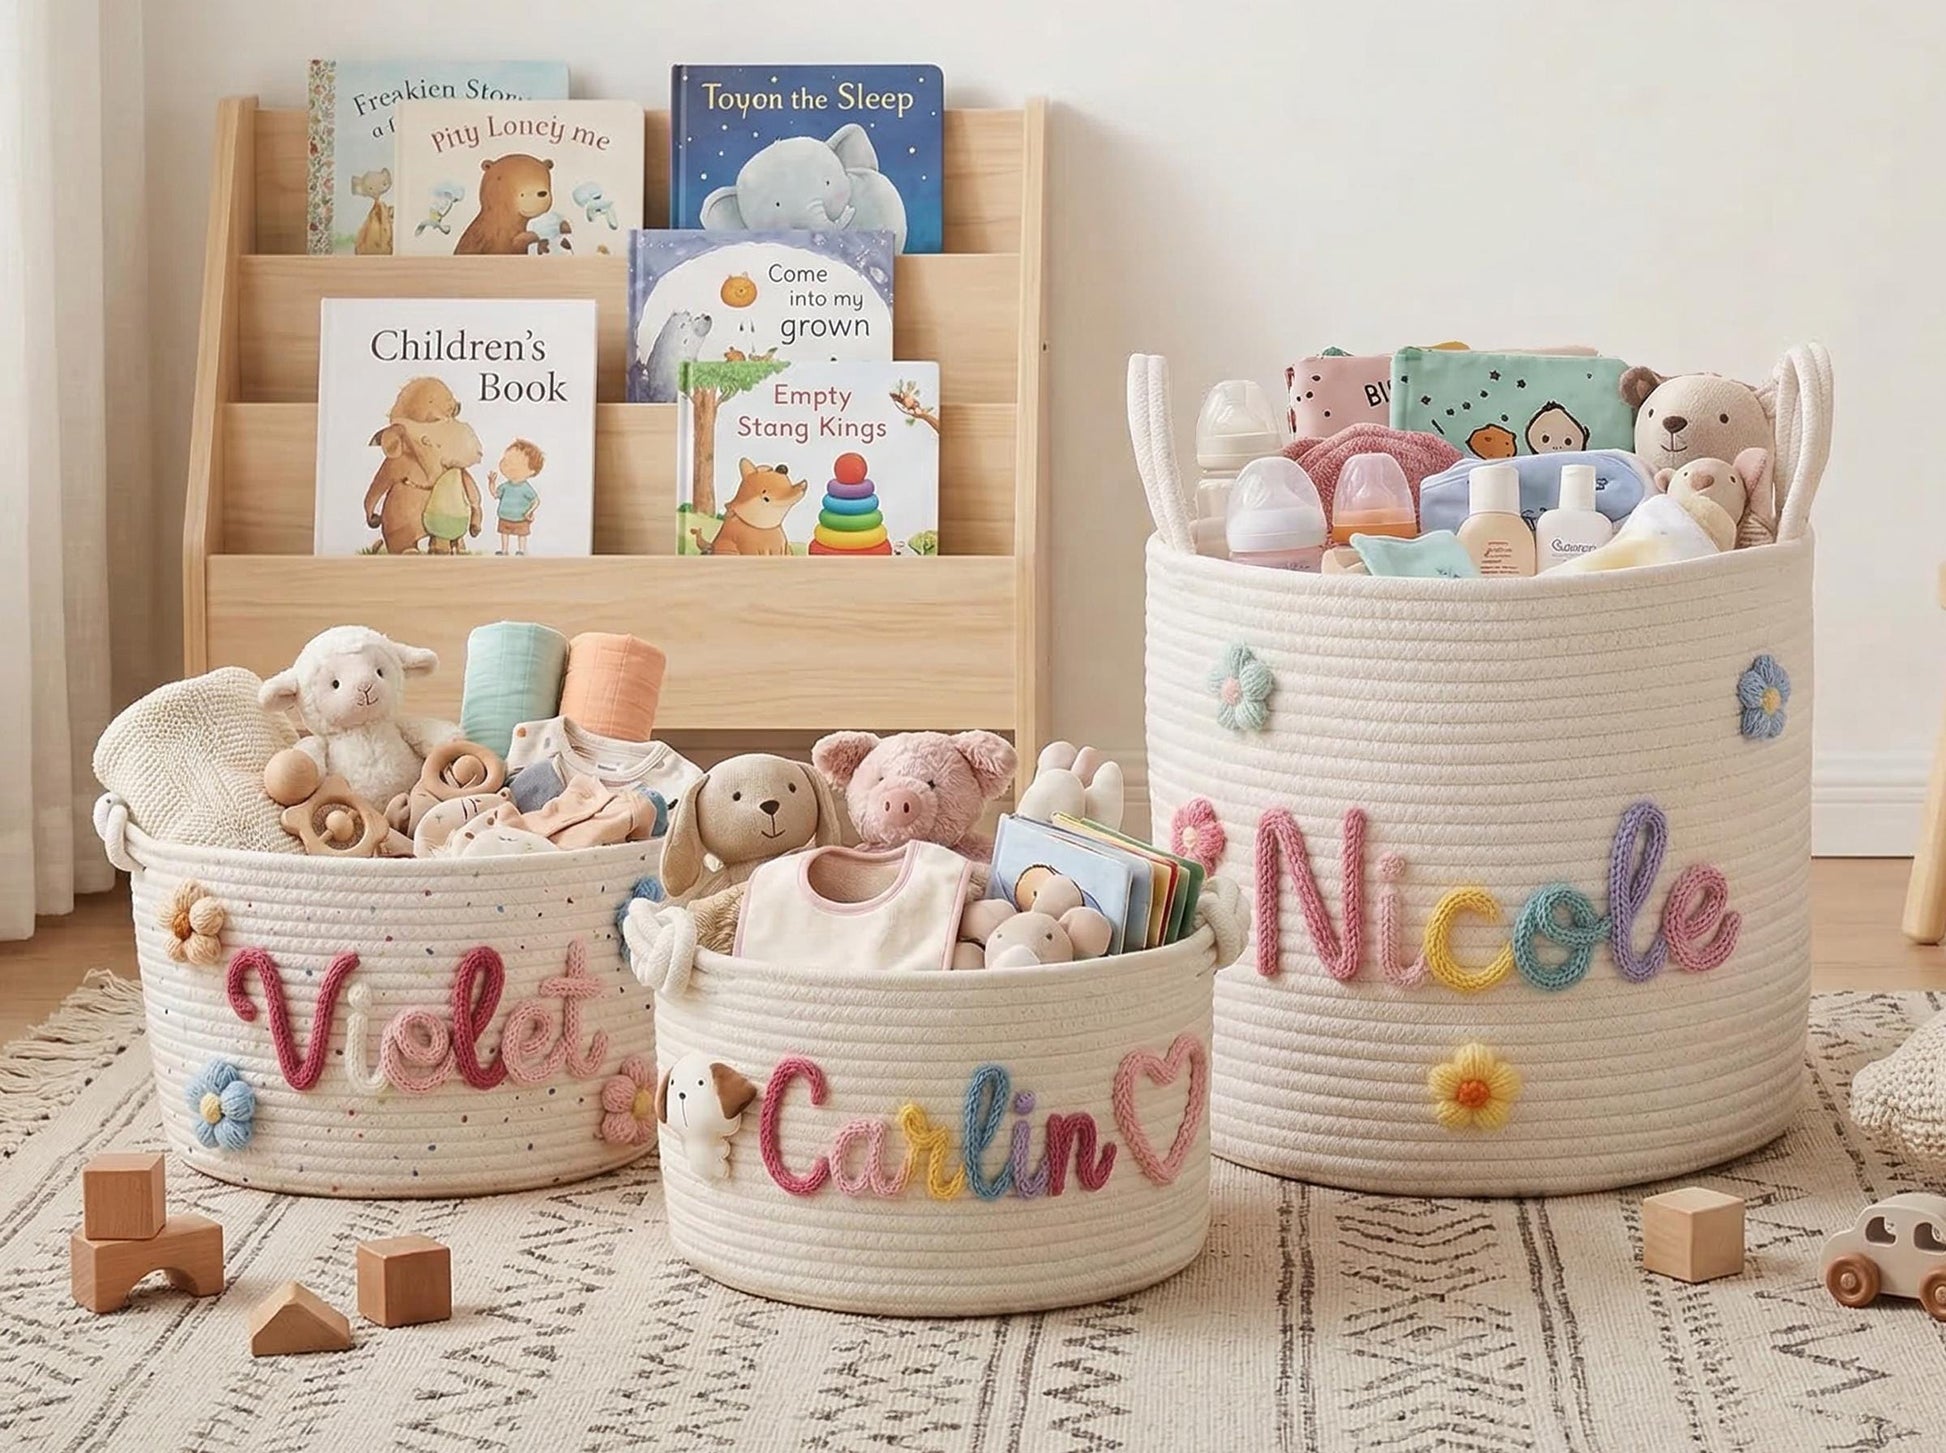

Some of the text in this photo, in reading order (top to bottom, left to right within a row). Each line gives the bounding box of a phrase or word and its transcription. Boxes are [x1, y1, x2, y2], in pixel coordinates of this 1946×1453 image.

[702, 83, 915, 119] Toyon the Sleep
[570, 125, 611, 151] me
[768, 263, 829, 284] Come
[790, 290, 864, 311] into my
[371, 329, 546, 362] Children's
[780, 318, 870, 345] grown
[479, 371, 568, 402] Book
[773, 384, 853, 411] Empty
[1364, 378, 1392, 407] BI
[737, 416, 887, 443] Stang Kings
[1256, 801, 1742, 994] Nicole
[227, 940, 608, 1095] Violet
[760, 1056, 1118, 1202] Carlin
